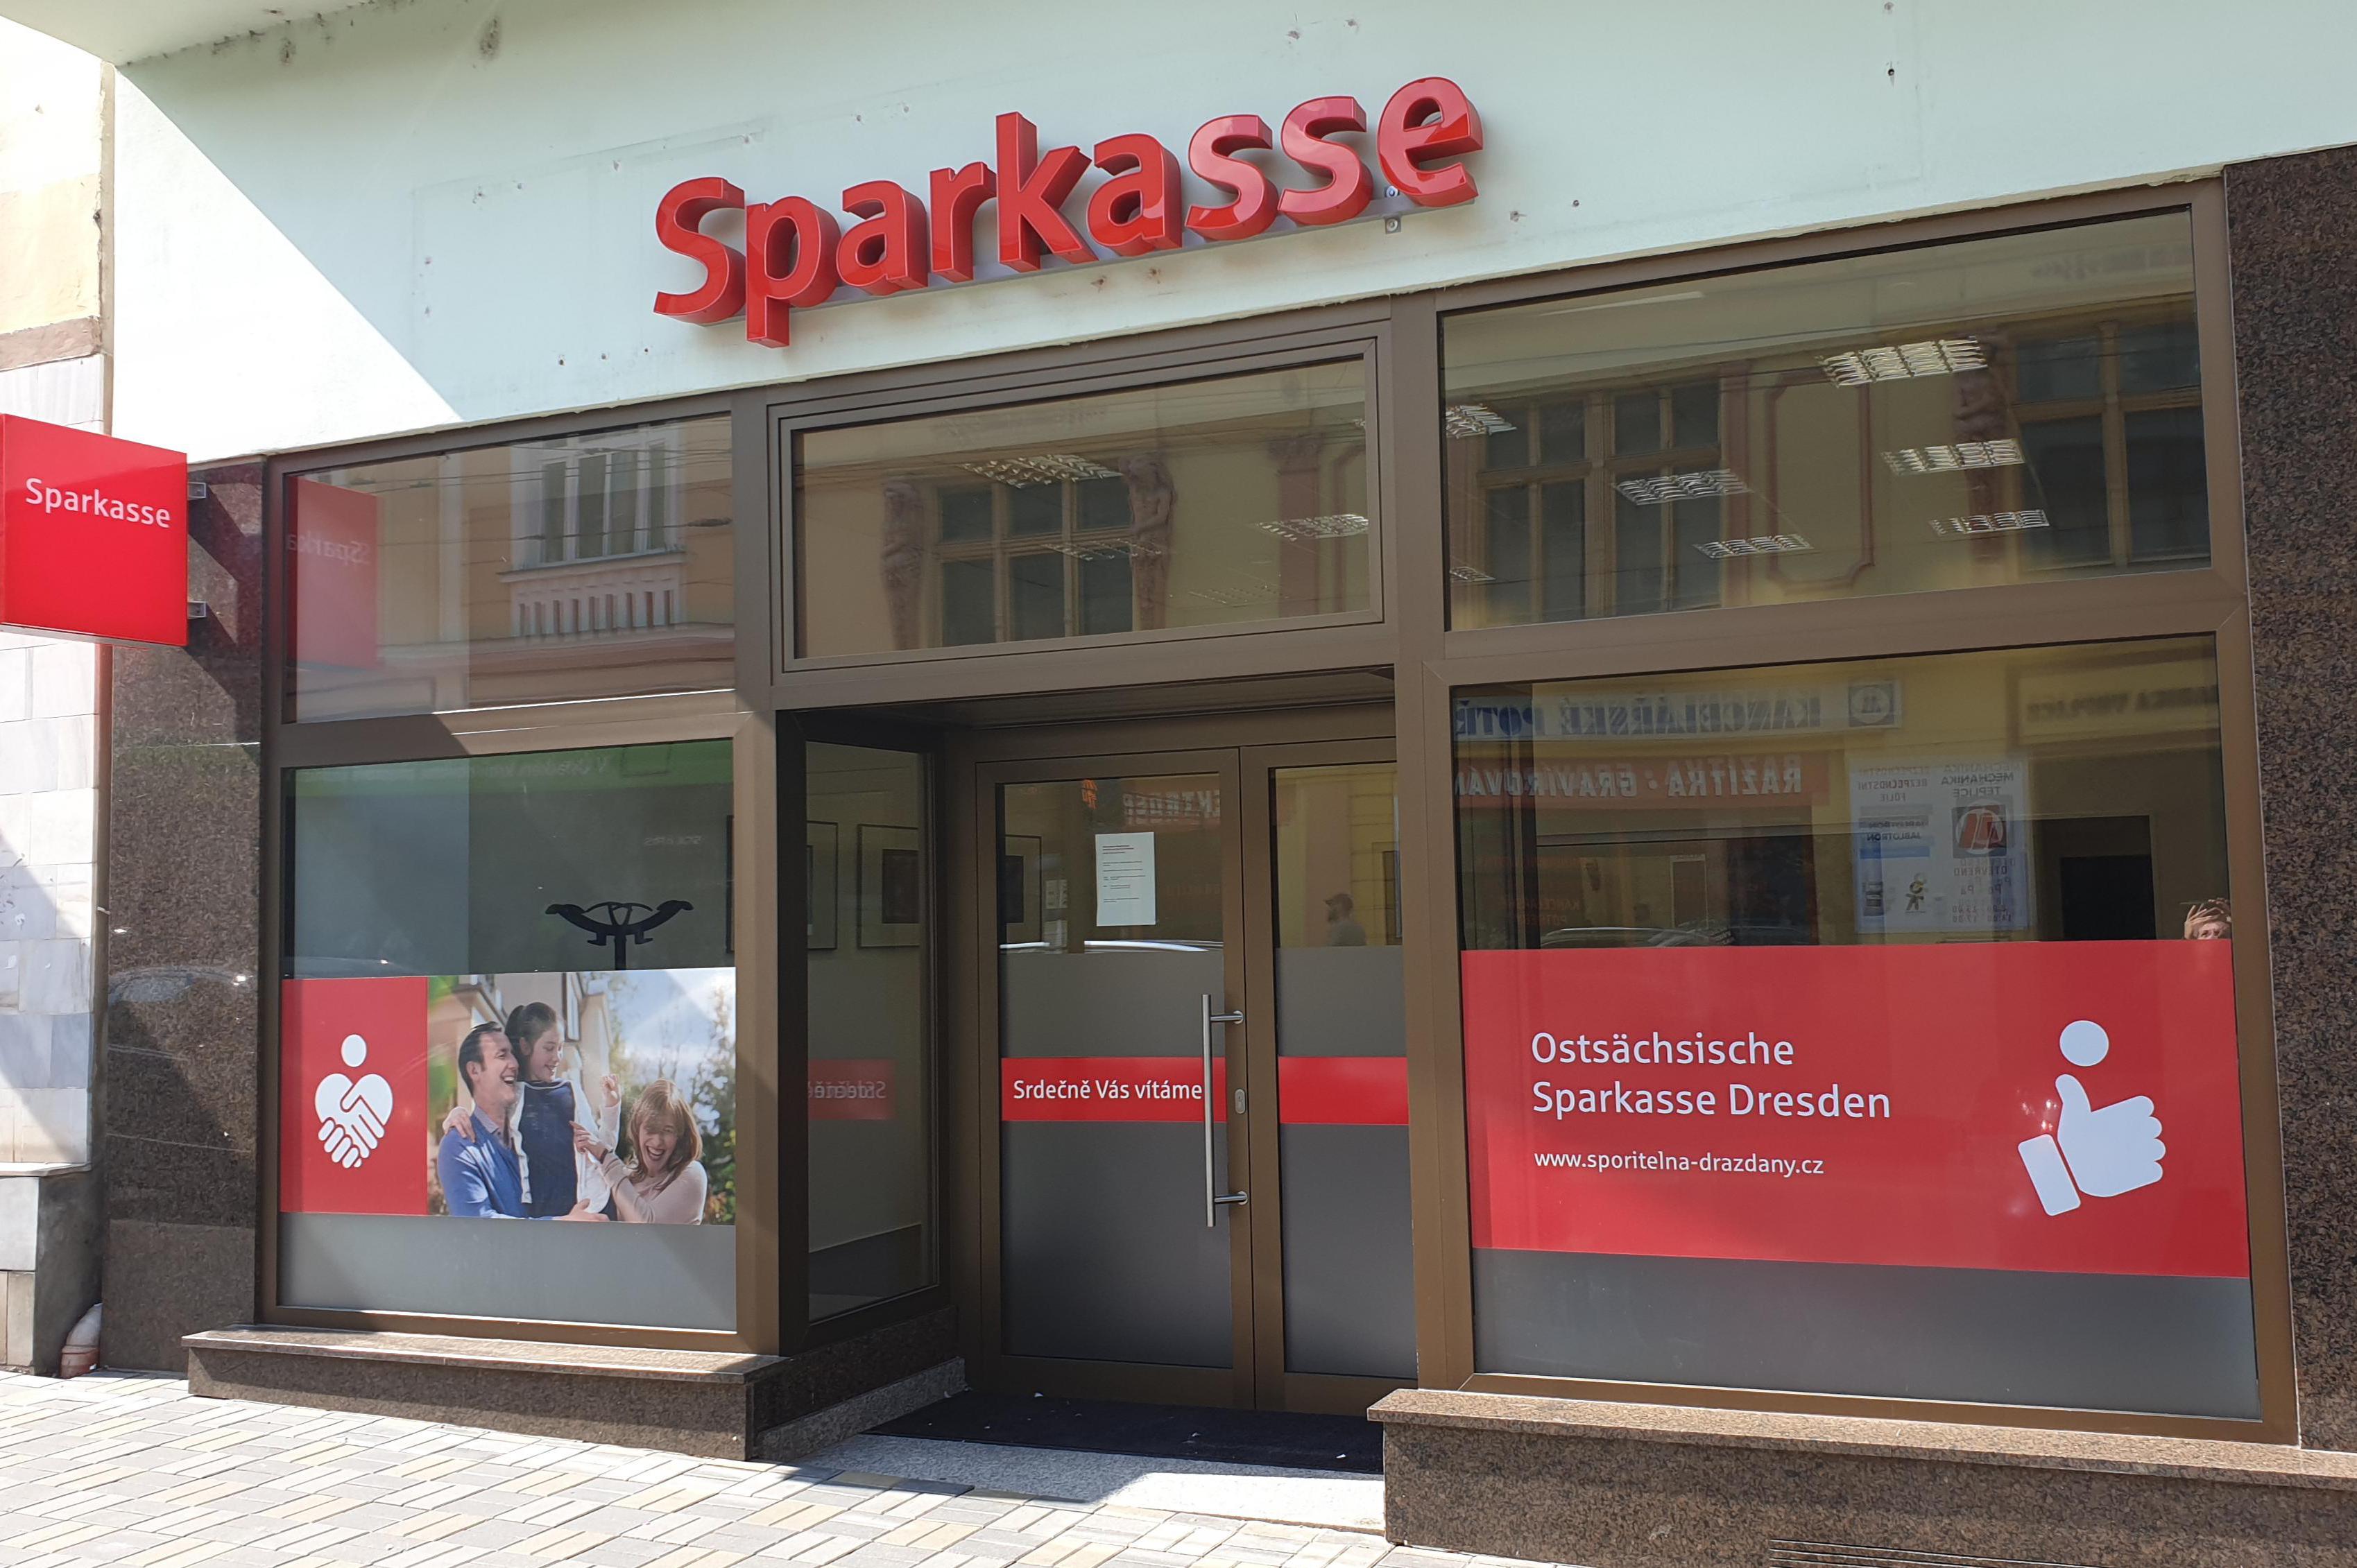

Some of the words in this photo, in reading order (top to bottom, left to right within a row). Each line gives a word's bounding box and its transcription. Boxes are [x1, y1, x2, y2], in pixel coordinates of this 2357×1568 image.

[654, 77, 1483, 347] Sparkasse
[26, 478, 171, 528] Sparkasse
[1532, 1031, 1794, 1065] Ostsächsische
[1013, 1079, 1091, 1099] Srdečně
[1095, 1079, 1130, 1099] Vás
[1134, 1079, 1203, 1099] vítáme
[1533, 1080, 1715, 1120] Sparkasse
[1729, 1083, 1890, 1118] Dresden
[1534, 1151, 1824, 1178] www.sporitelna-drazdany.cz
